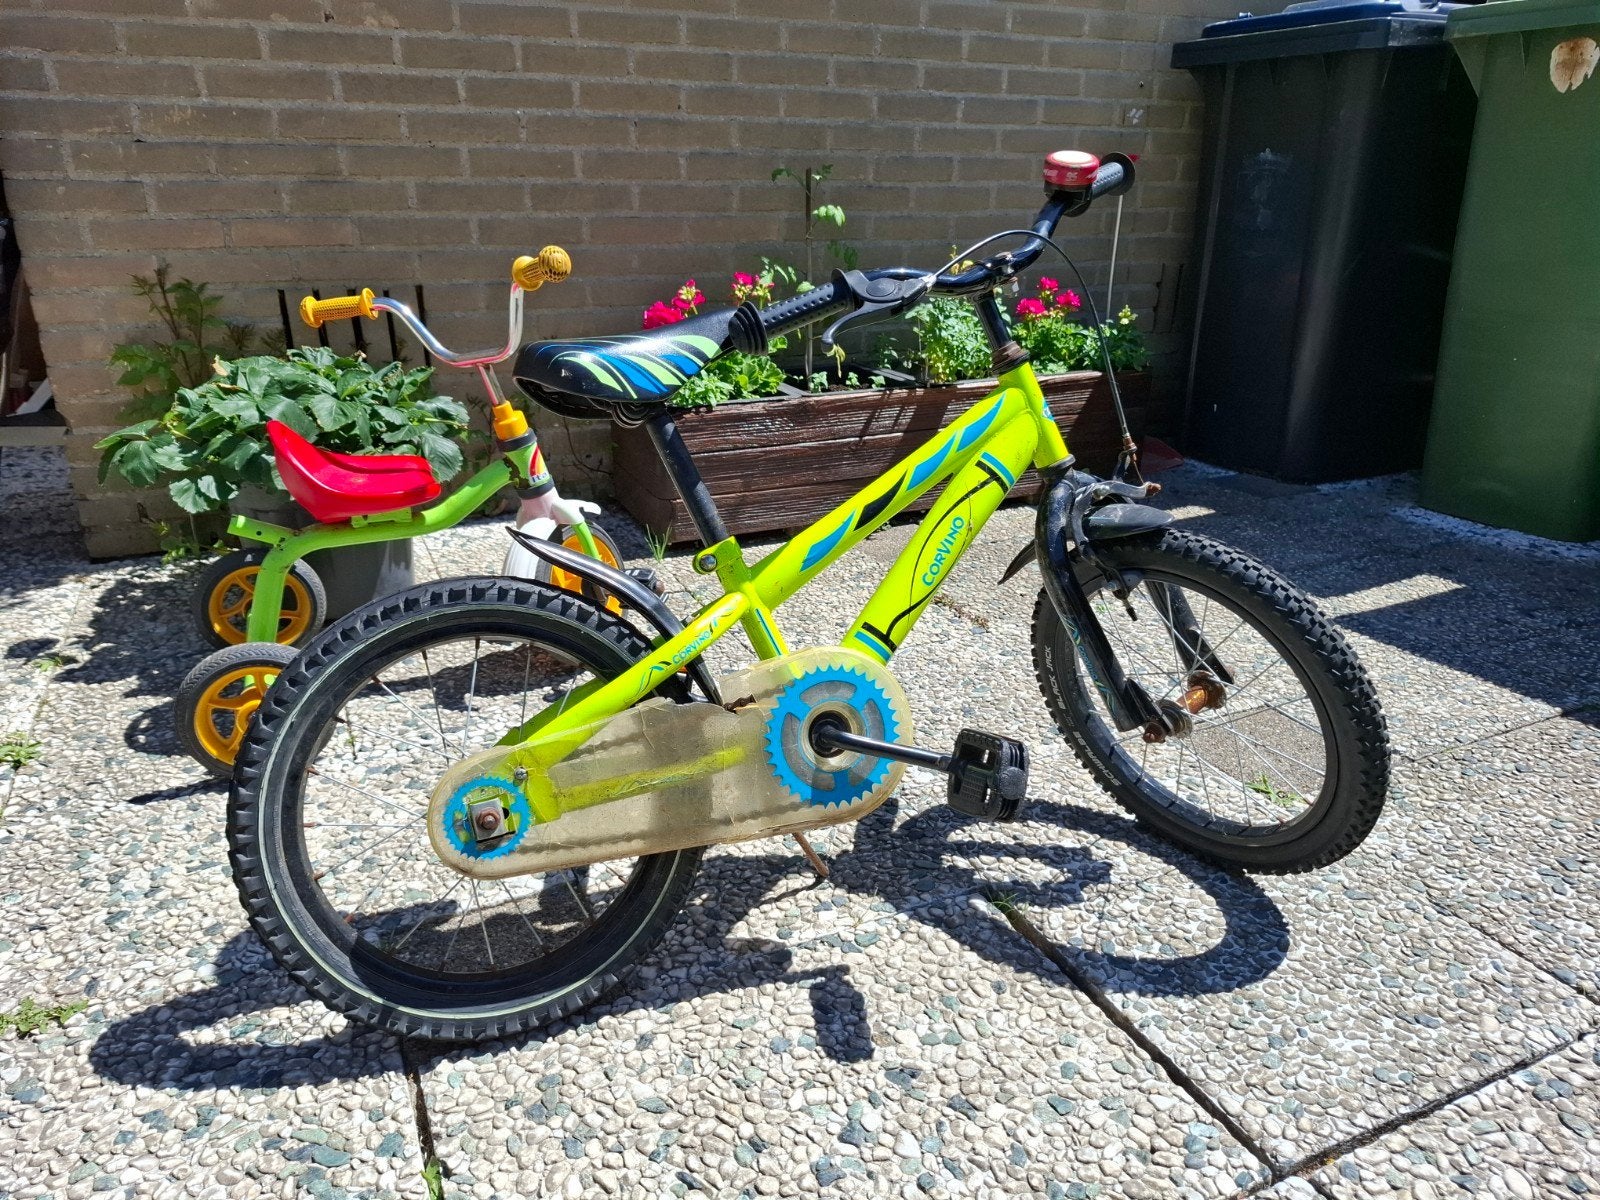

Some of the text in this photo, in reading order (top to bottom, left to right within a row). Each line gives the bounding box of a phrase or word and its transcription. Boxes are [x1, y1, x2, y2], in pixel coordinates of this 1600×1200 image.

[921, 516, 965, 587] CORVINO
[672, 630, 711, 664] CORVINO
[1044, 644, 1122, 786] SCHWALBE BLACK JACK
